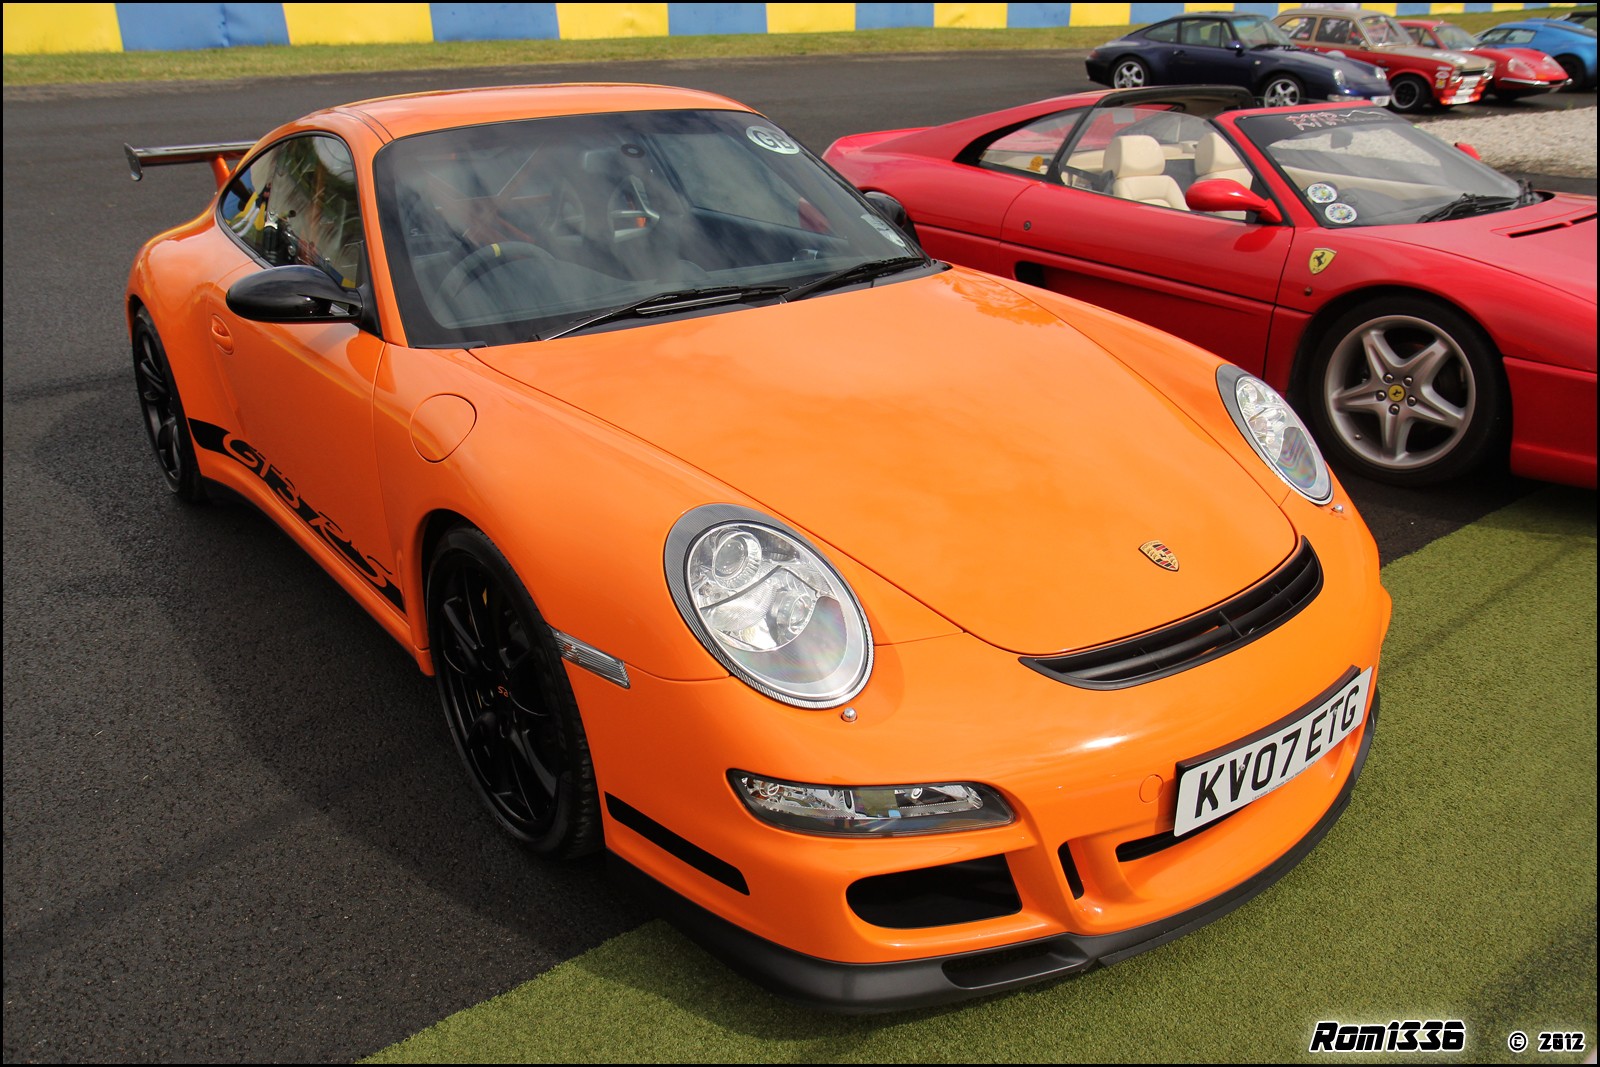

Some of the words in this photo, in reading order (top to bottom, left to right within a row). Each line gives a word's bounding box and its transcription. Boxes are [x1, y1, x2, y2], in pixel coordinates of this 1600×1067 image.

[753, 130, 795, 150] GB
[223, 433, 300, 509] GT3
[308, 511, 392, 588] RS
